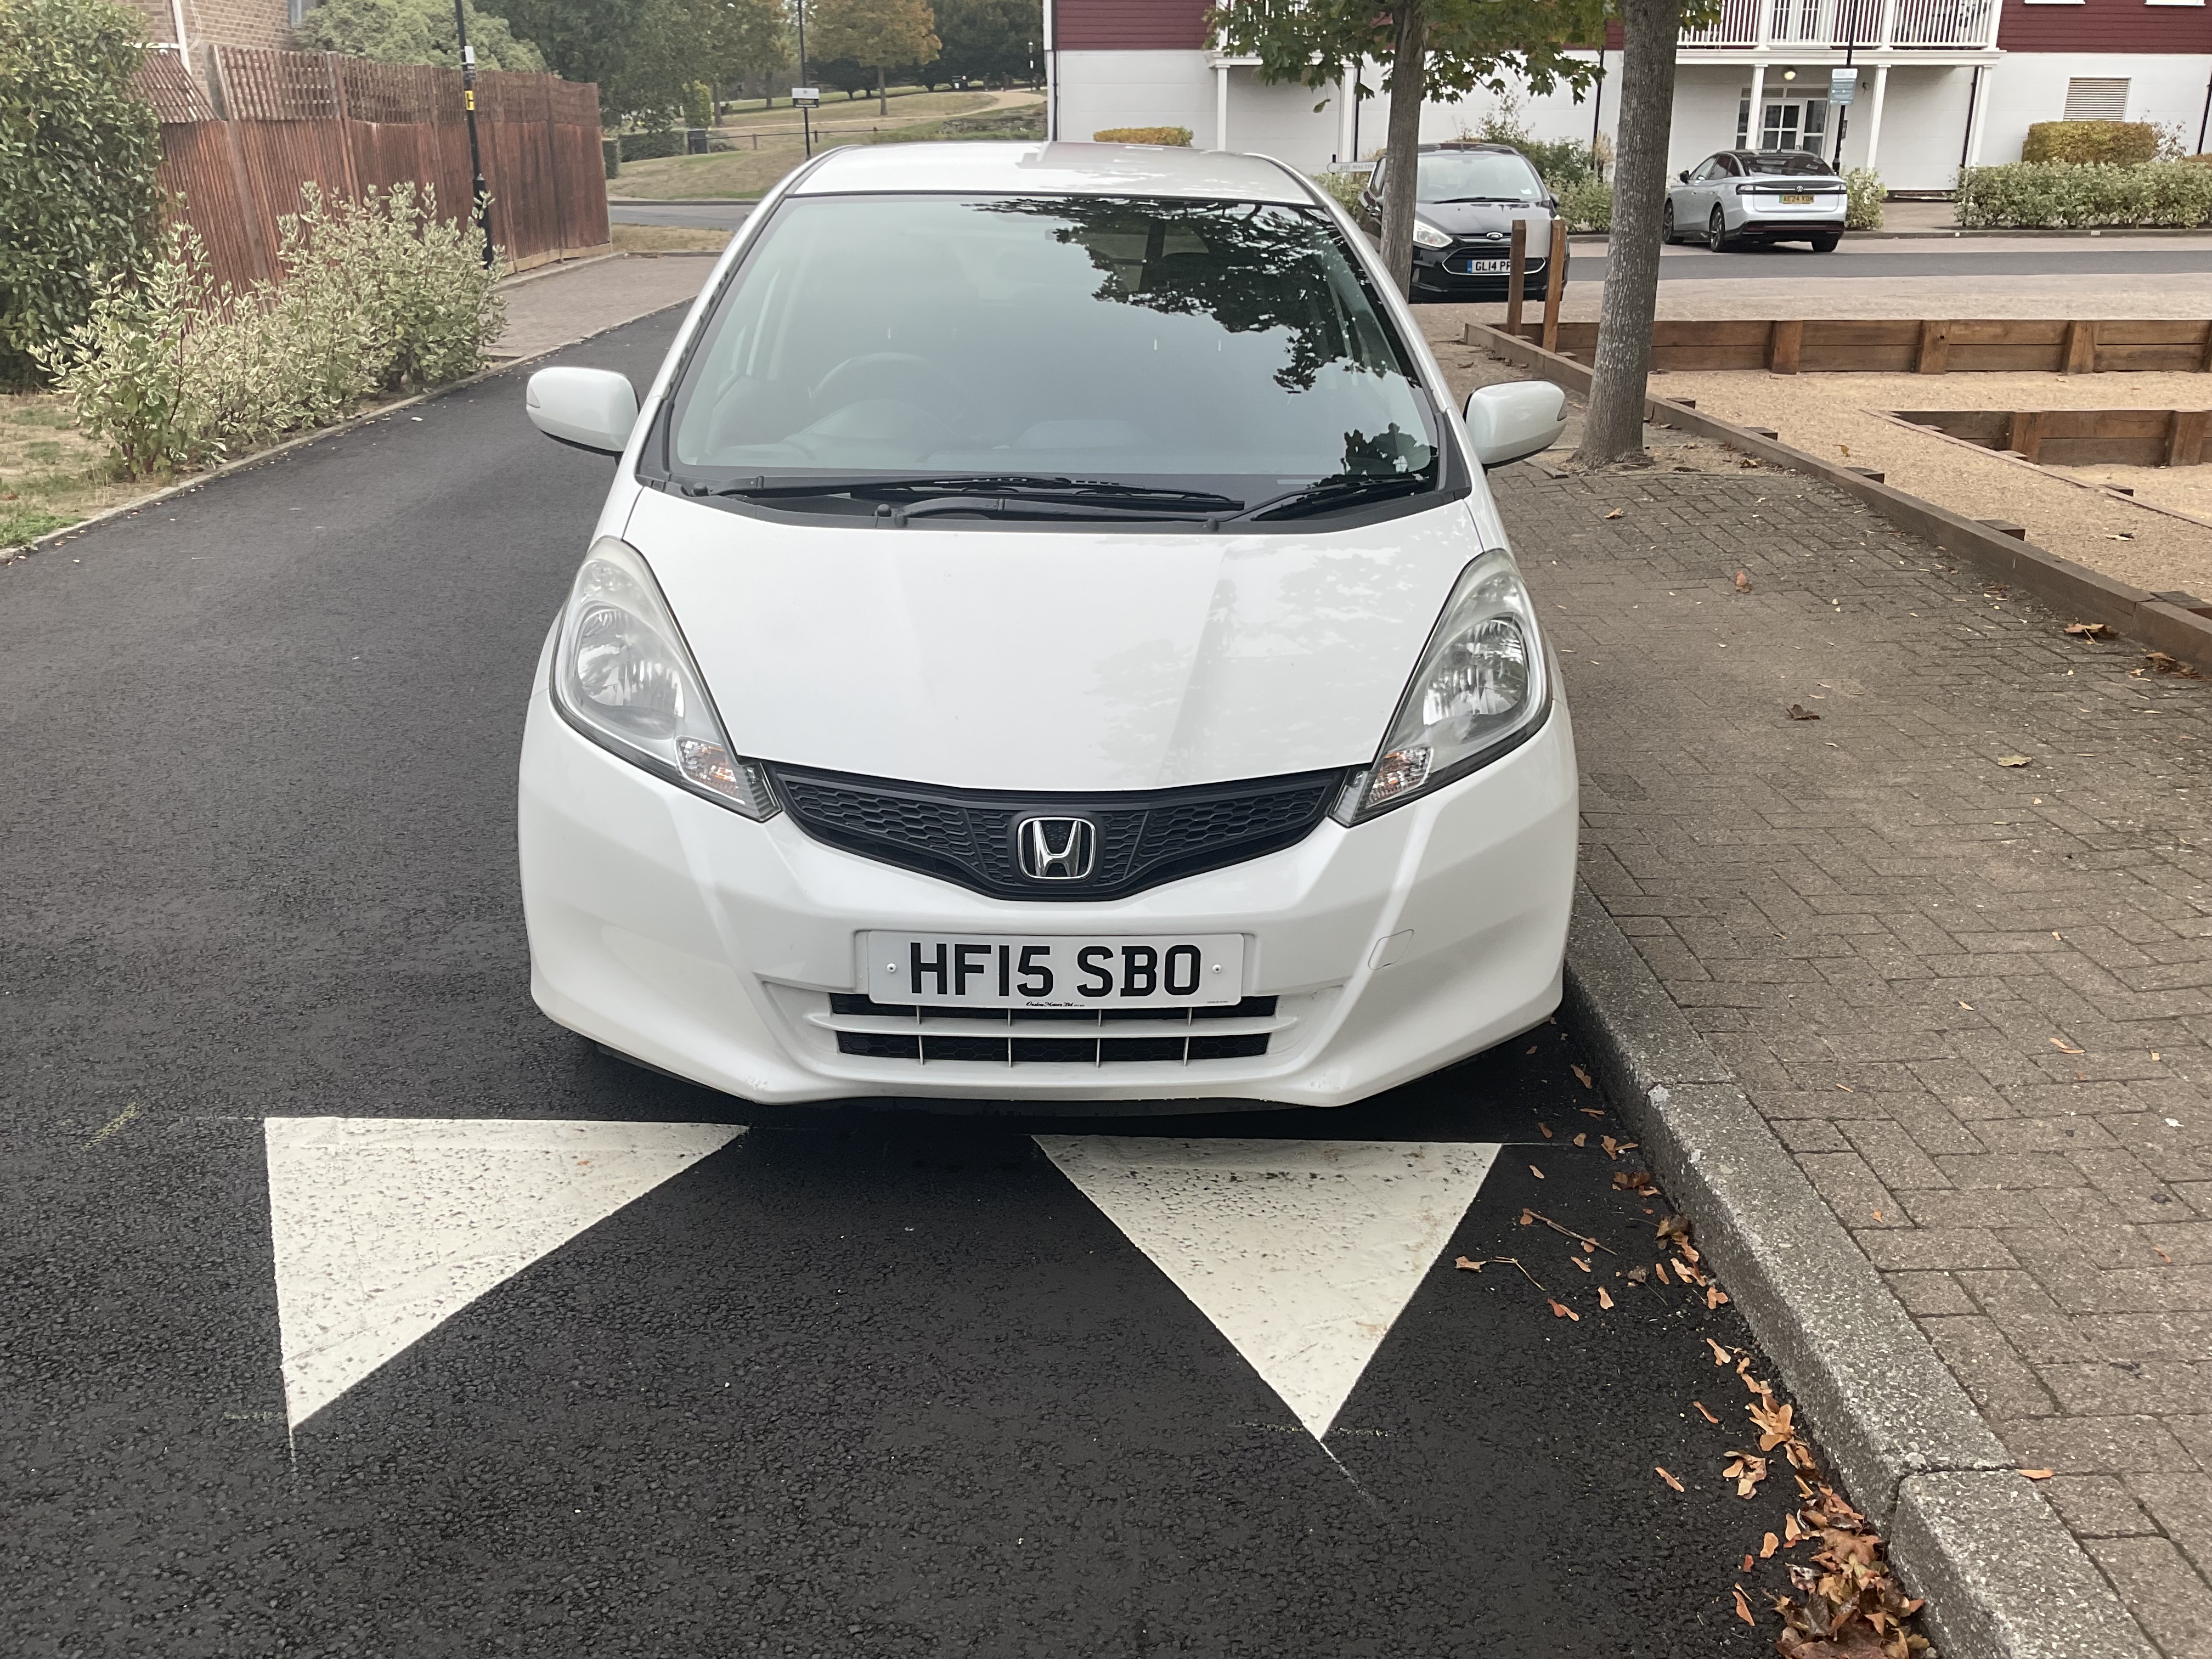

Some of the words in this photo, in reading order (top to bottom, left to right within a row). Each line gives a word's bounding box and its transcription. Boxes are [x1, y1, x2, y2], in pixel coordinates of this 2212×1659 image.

[1475, 261, 1497, 271] GL14
[910, 942, 1054, 997] HF15
[1076, 944, 1201, 997] SBO
